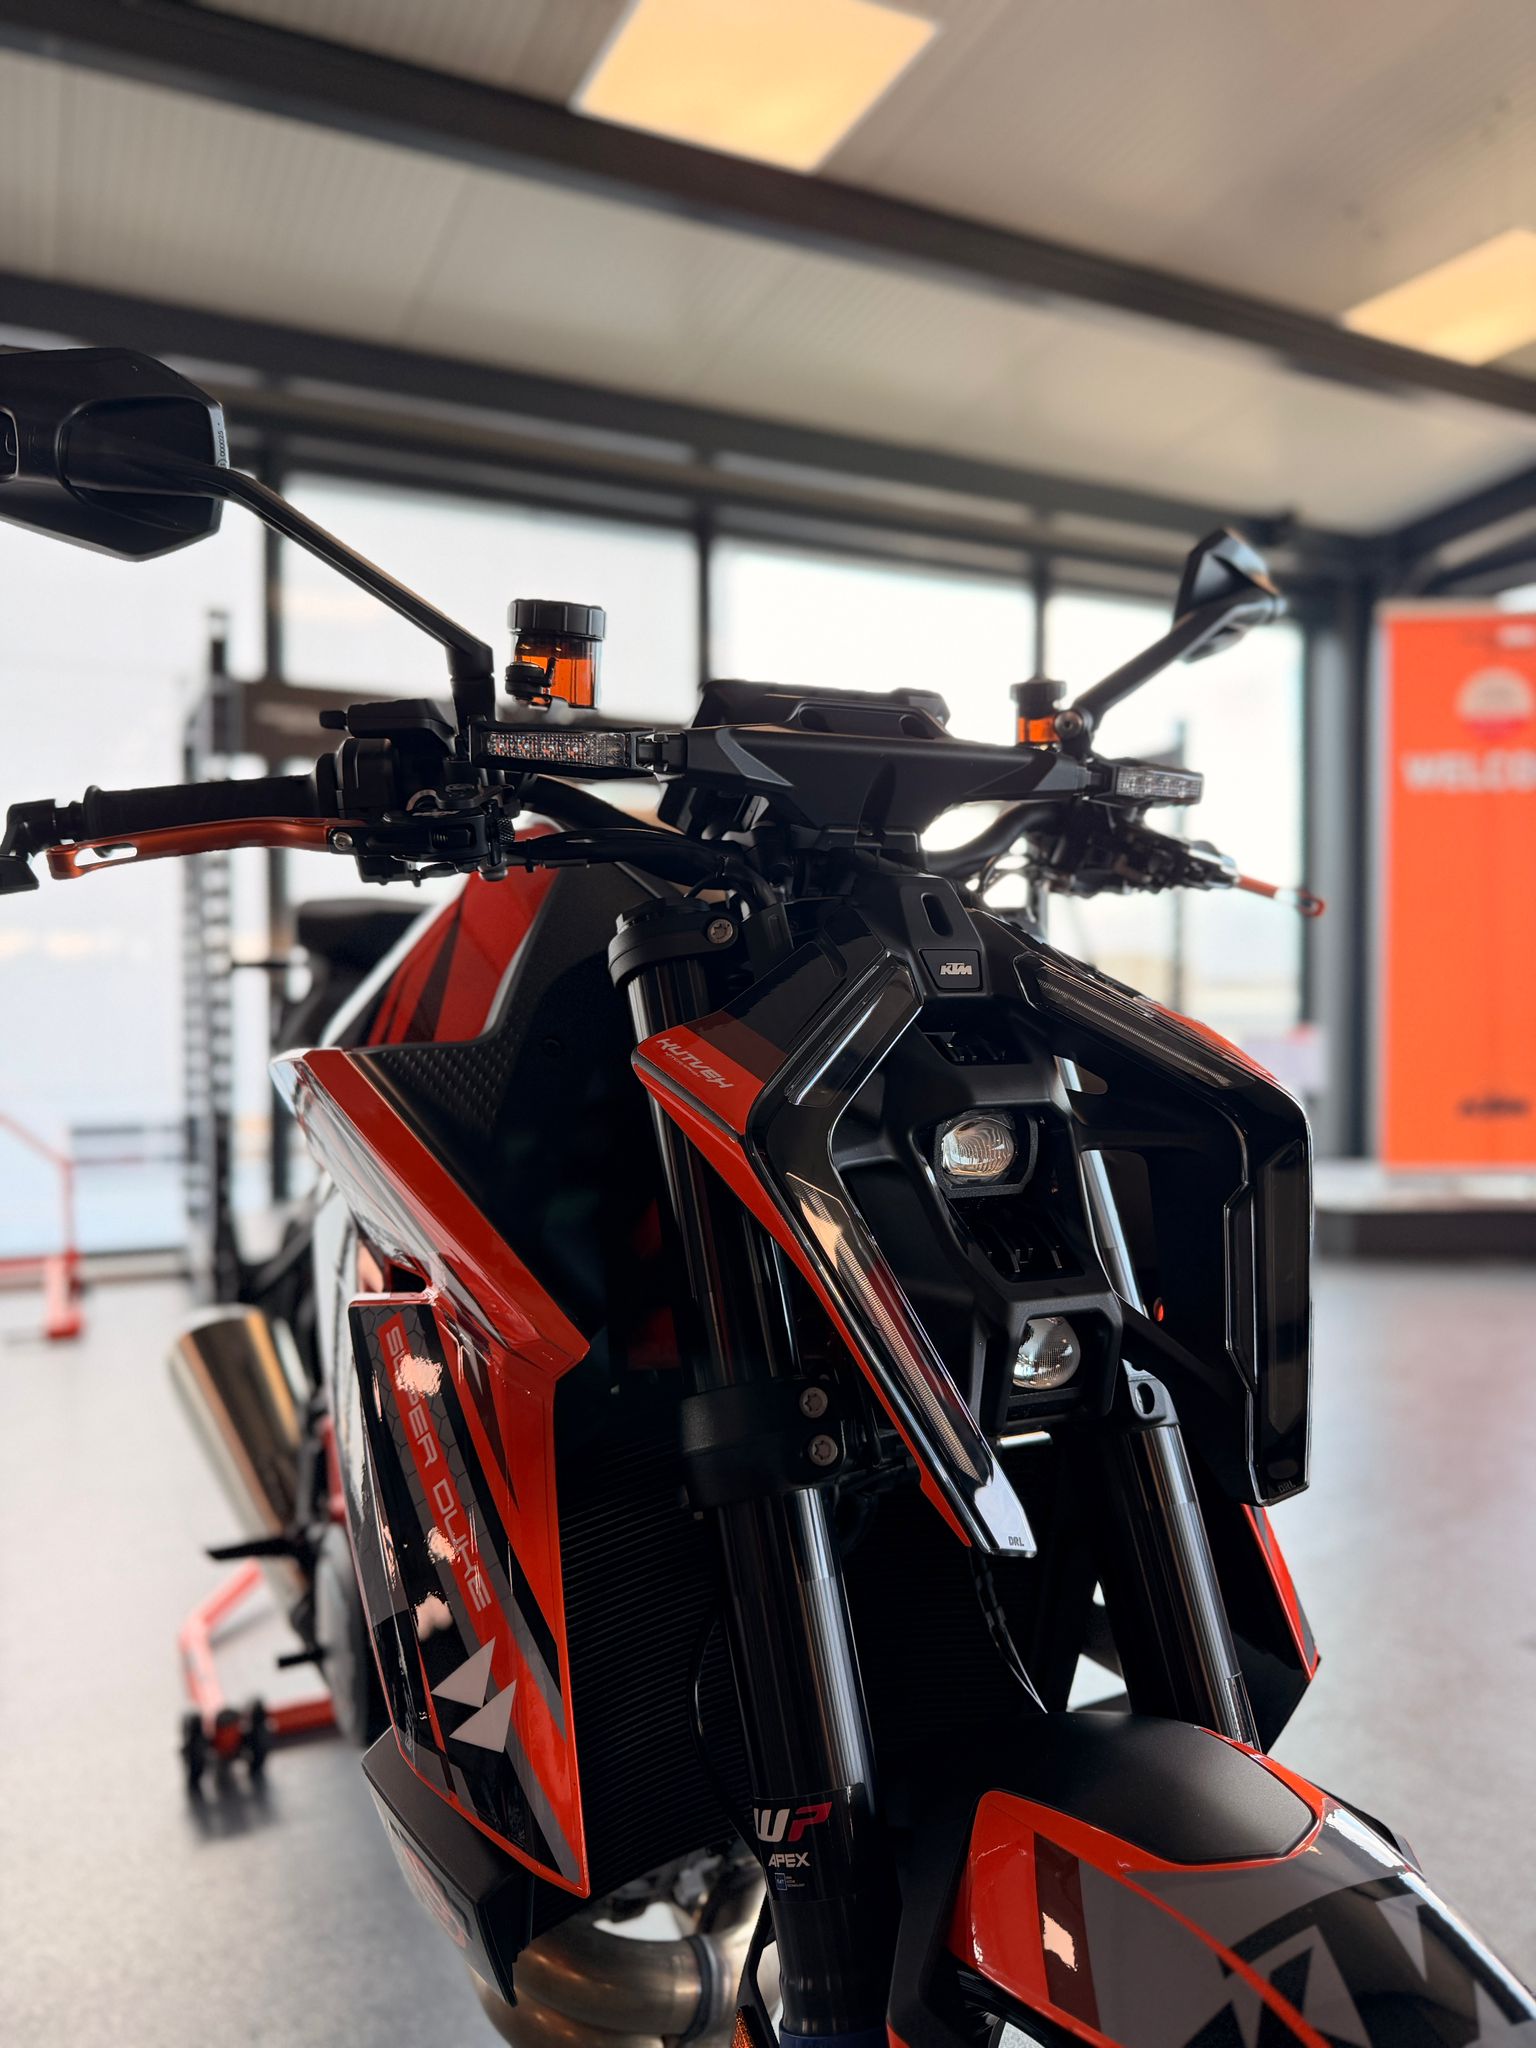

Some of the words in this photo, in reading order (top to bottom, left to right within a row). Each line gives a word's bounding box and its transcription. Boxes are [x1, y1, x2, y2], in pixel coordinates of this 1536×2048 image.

[940, 962, 972, 975] KTM
[433, 1479, 492, 1612] DUKE
[1008, 1536, 1025, 1547] DRL
[754, 1802, 832, 1843] WP
[768, 1852, 811, 1868] APEX
